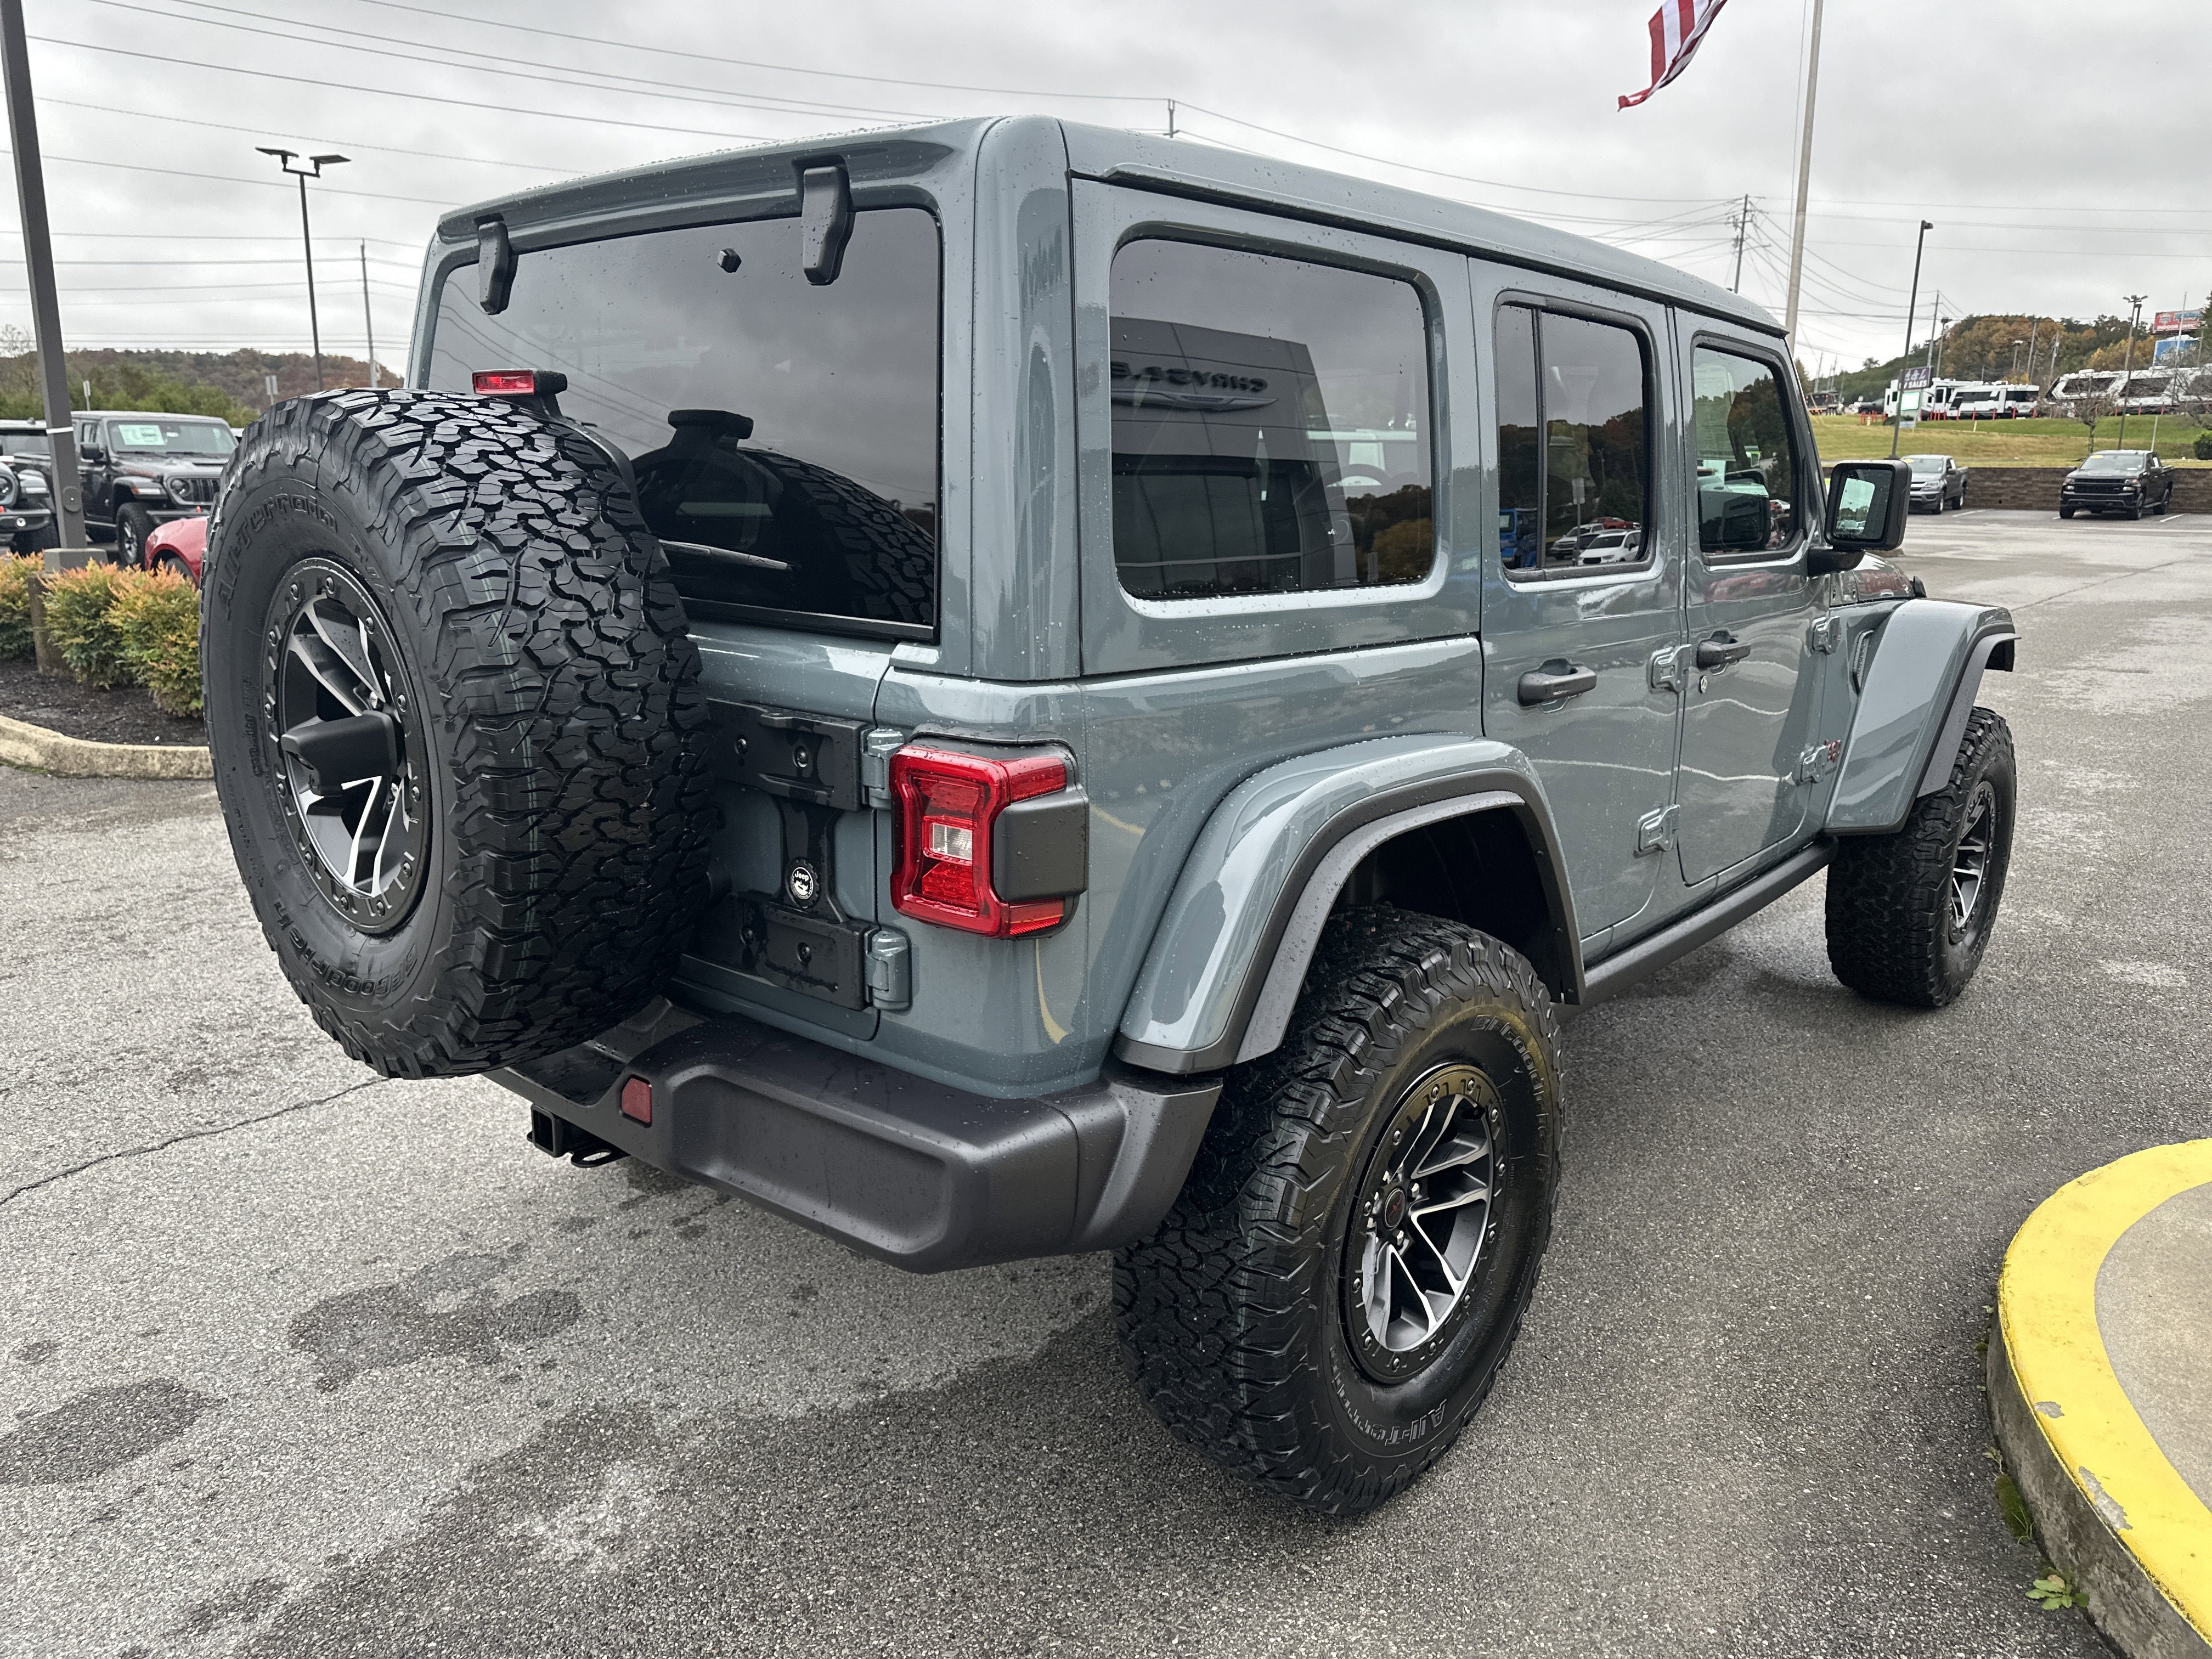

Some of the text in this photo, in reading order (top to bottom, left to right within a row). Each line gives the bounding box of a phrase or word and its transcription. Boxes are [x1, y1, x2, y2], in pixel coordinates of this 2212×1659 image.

[1908, 380, 1927, 389] SALES
[218, 493, 338, 620] All-Terrain
[794, 871, 809, 882] Jeep
[274, 901, 417, 999] BFGoodrich
[1471, 1015, 1550, 1181] BFGoodrich
[1329, 1344, 1447, 1446] All-Terrain
